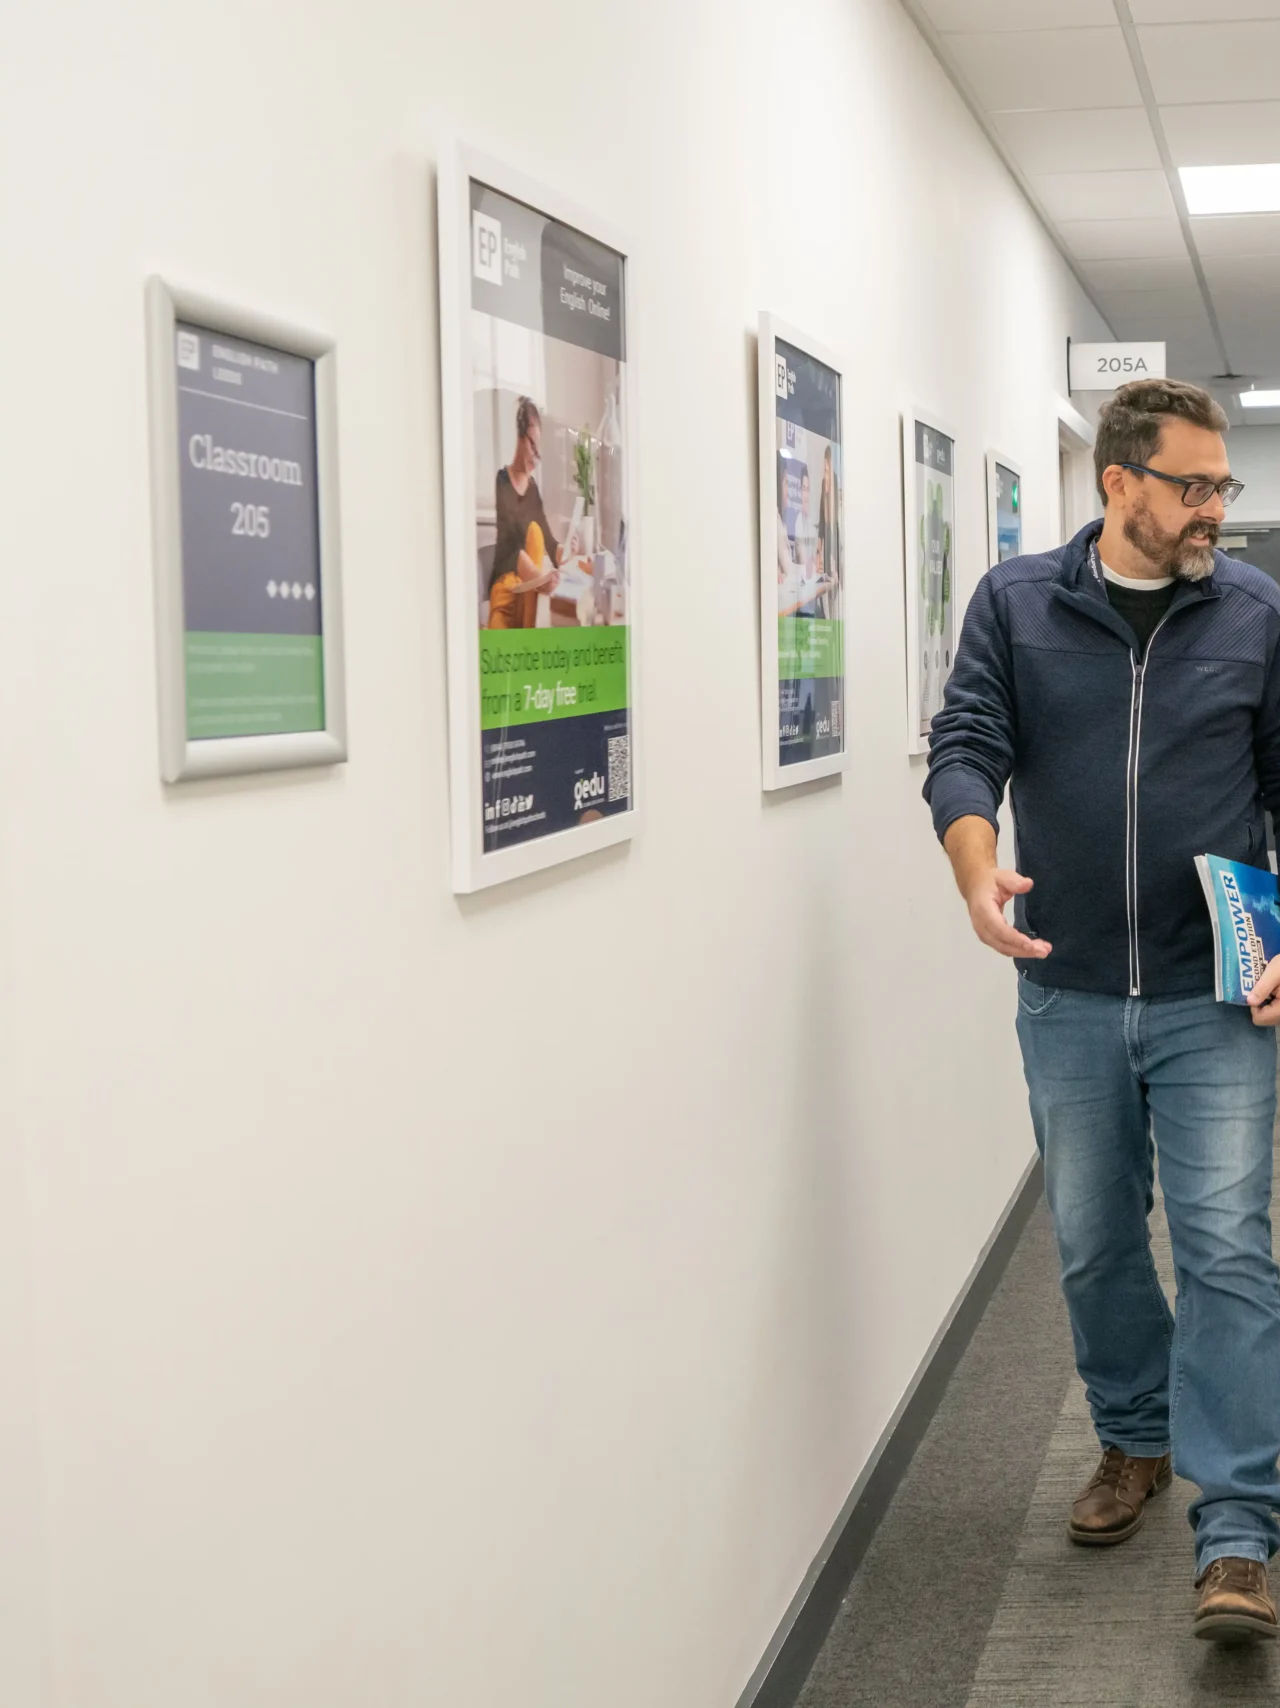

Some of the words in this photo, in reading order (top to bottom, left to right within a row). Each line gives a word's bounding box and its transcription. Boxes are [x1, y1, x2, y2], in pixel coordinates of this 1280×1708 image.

[479, 226, 497, 268] EP
[562, 261, 592, 289] Improve
[592, 279, 607, 296] your
[560, 286, 586, 312] English
[588, 298, 611, 321] Online!
[777, 363, 786, 390] EP
[1097, 357, 1148, 373] 205A
[188, 433, 304, 487] Classroom
[230, 501, 271, 539] 205
[481, 646, 540, 676] Subscribe
[541, 645, 571, 675] today
[573, 643, 592, 668] and
[592, 639, 625, 665] benefit
[482, 688, 513, 716] from
[514, 692, 523, 713] a
[523, 682, 556, 714] 7-day
[556, 680, 577, 707] free
[577, 678, 598, 704] trial
[574, 771, 605, 811] gedu
[1223, 875, 1254, 993] EMPOWER
[1245, 916, 1257, 953] EDITION
